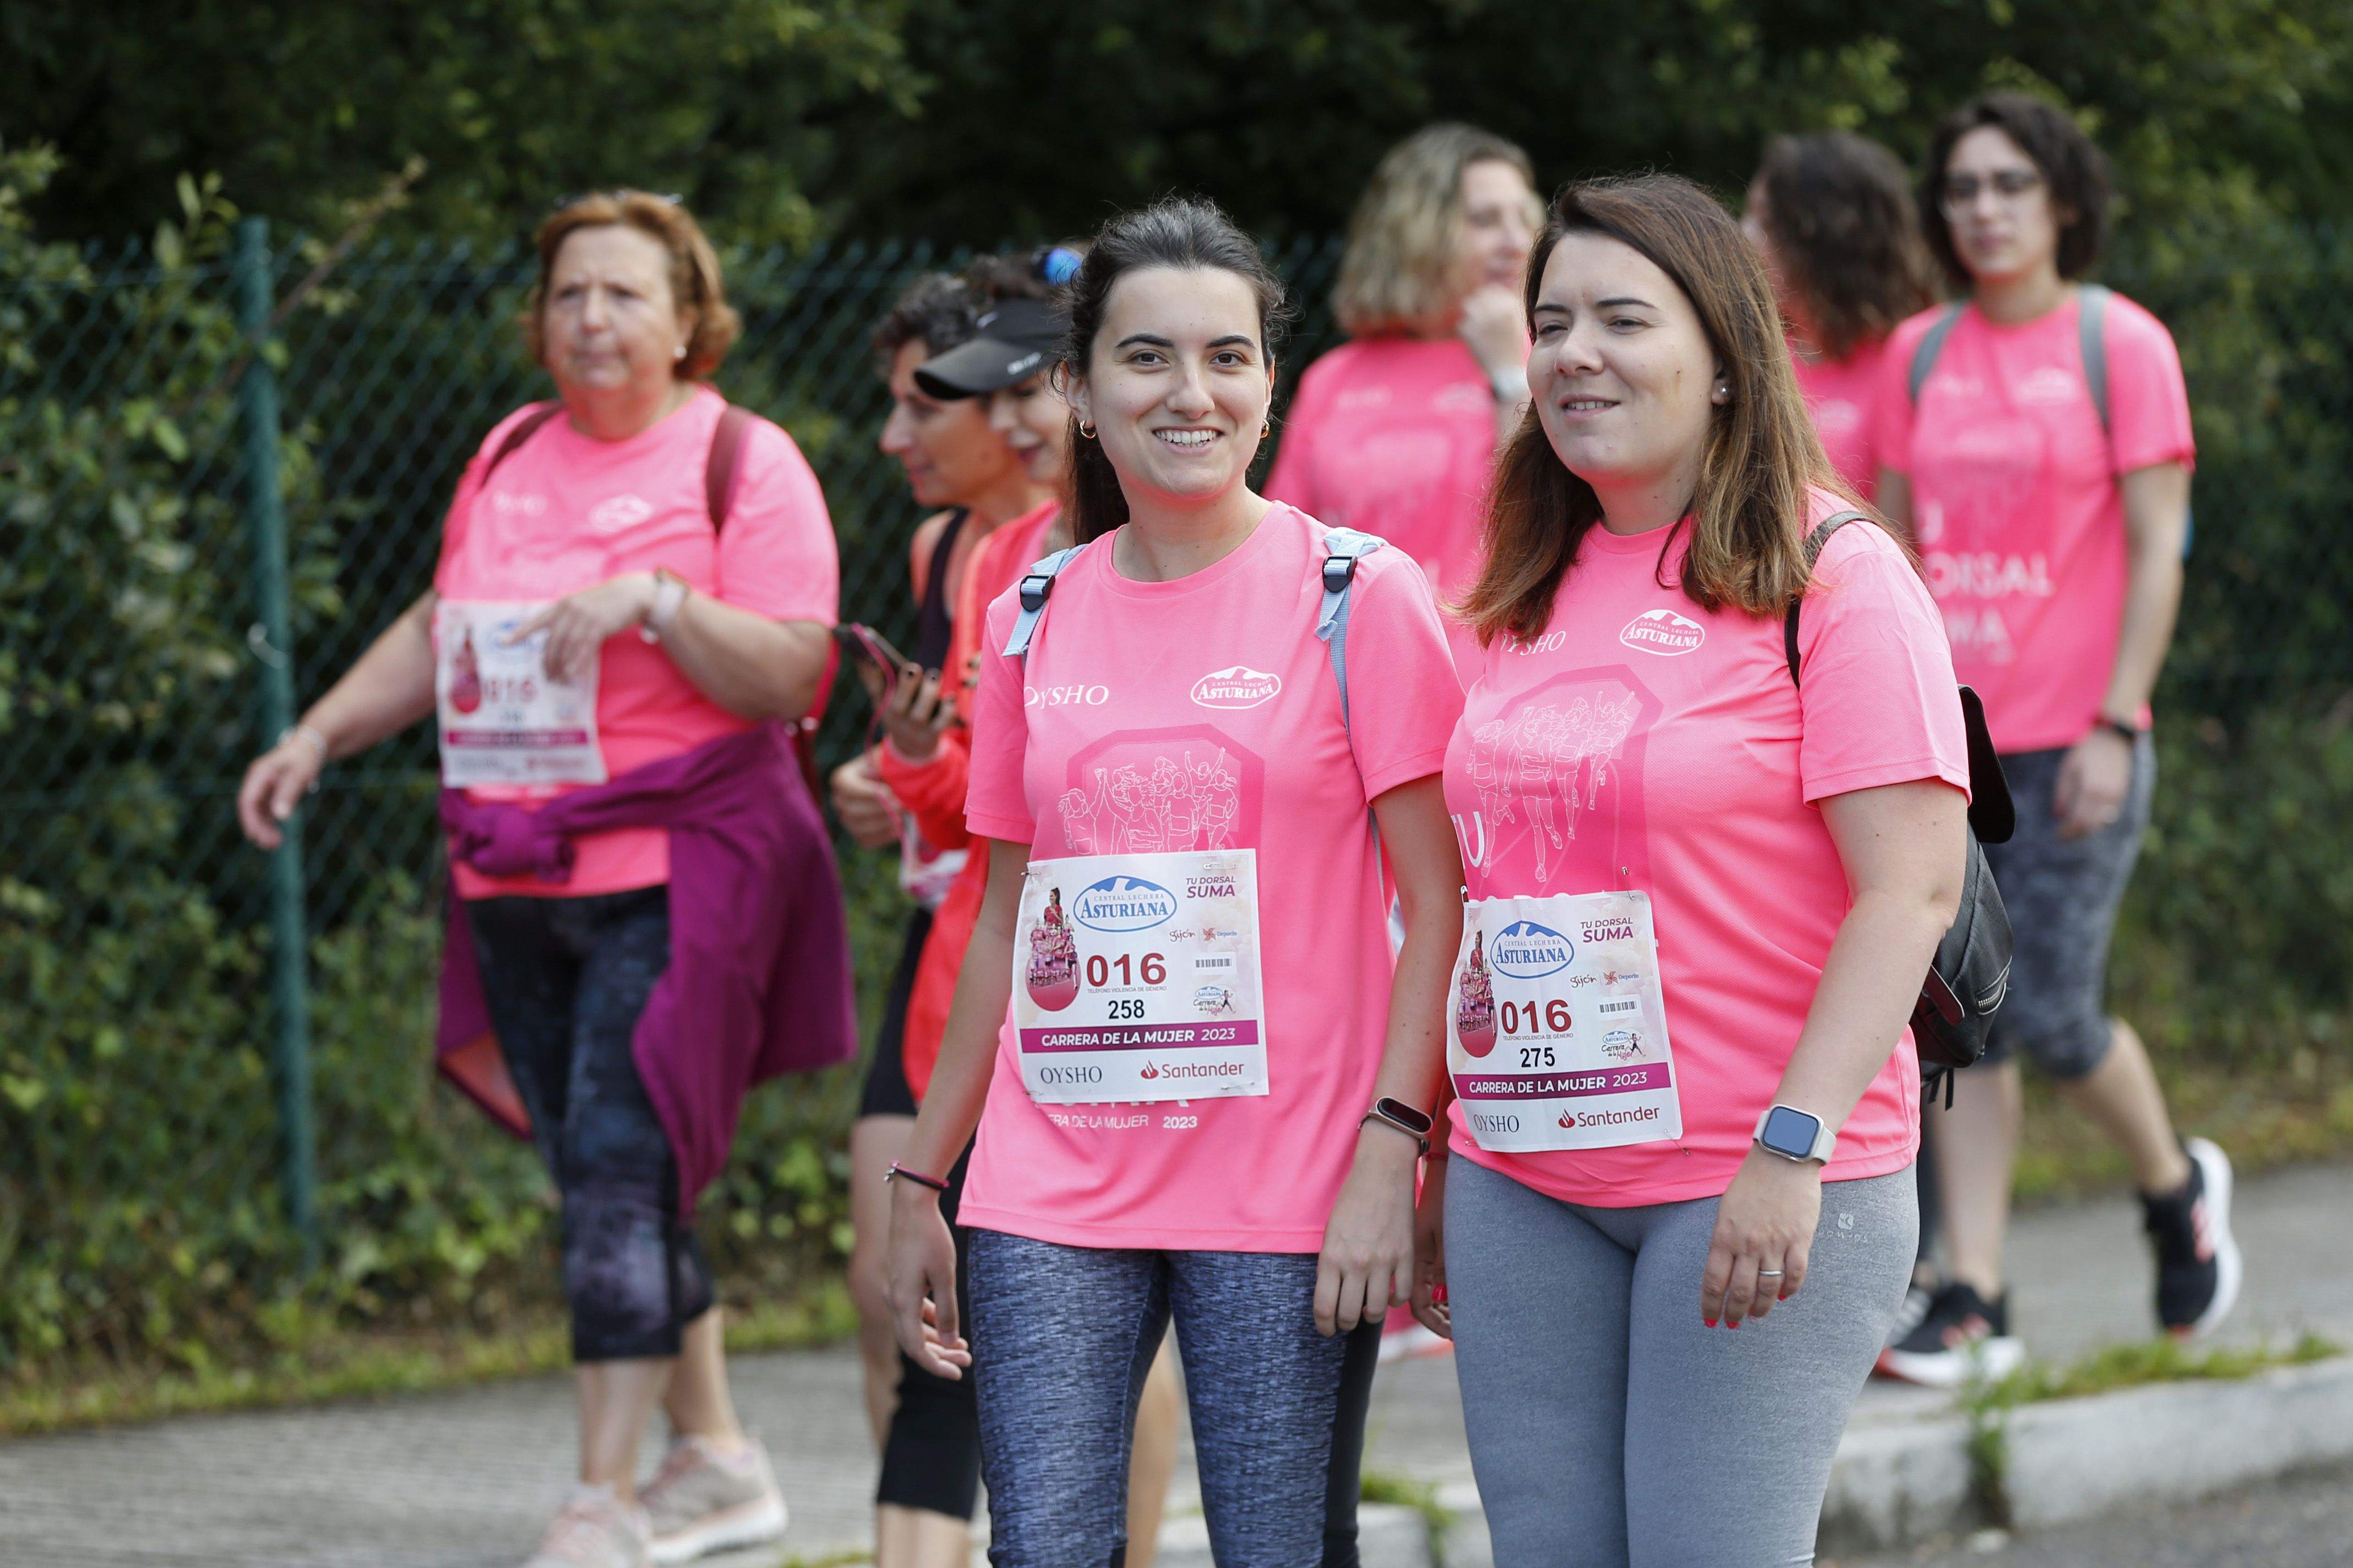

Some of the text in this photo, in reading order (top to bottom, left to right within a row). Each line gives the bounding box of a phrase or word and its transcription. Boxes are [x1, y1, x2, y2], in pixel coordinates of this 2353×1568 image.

[1624, 624, 1697, 647] ASTURIANA
[1640, 621, 1670, 631] CENTRAL
[1023, 685, 1109, 709] OYSHO
[1197, 683, 1274, 700] ASTURIANA
[1199, 876, 1236, 884] DORSAL
[1186, 885, 1236, 898] SUMA
[1080, 897, 1169, 919] ASTURIANA
[1595, 917, 1633, 928] DORSAL
[1583, 926, 1633, 943] SUMA
[1496, 942, 1567, 964] ASTURIANA
[1086, 952, 1167, 987] 016
[1108, 1000, 1145, 1019] 258
[1501, 1000, 1572, 1034] 016
[1041, 1027, 1236, 1047] CARRERA DE LA MUJER 2023
[1520, 1047, 1555, 1068] 275
[1040, 1065, 1103, 1084] OYSHO
[1162, 1061, 1245, 1079] Santander
[1469, 1071, 1647, 1094] CARRERA DE LA MUJER 2023
[1072, 1115, 1087, 1128] DE
[1089, 1115, 1103, 1128] LA
[1104, 1115, 1149, 1129] MUJER
[1162, 1115, 1198, 1129] 2023
[1473, 1114, 1520, 1133] OYSHO
[1577, 1106, 1660, 1127] Santander
